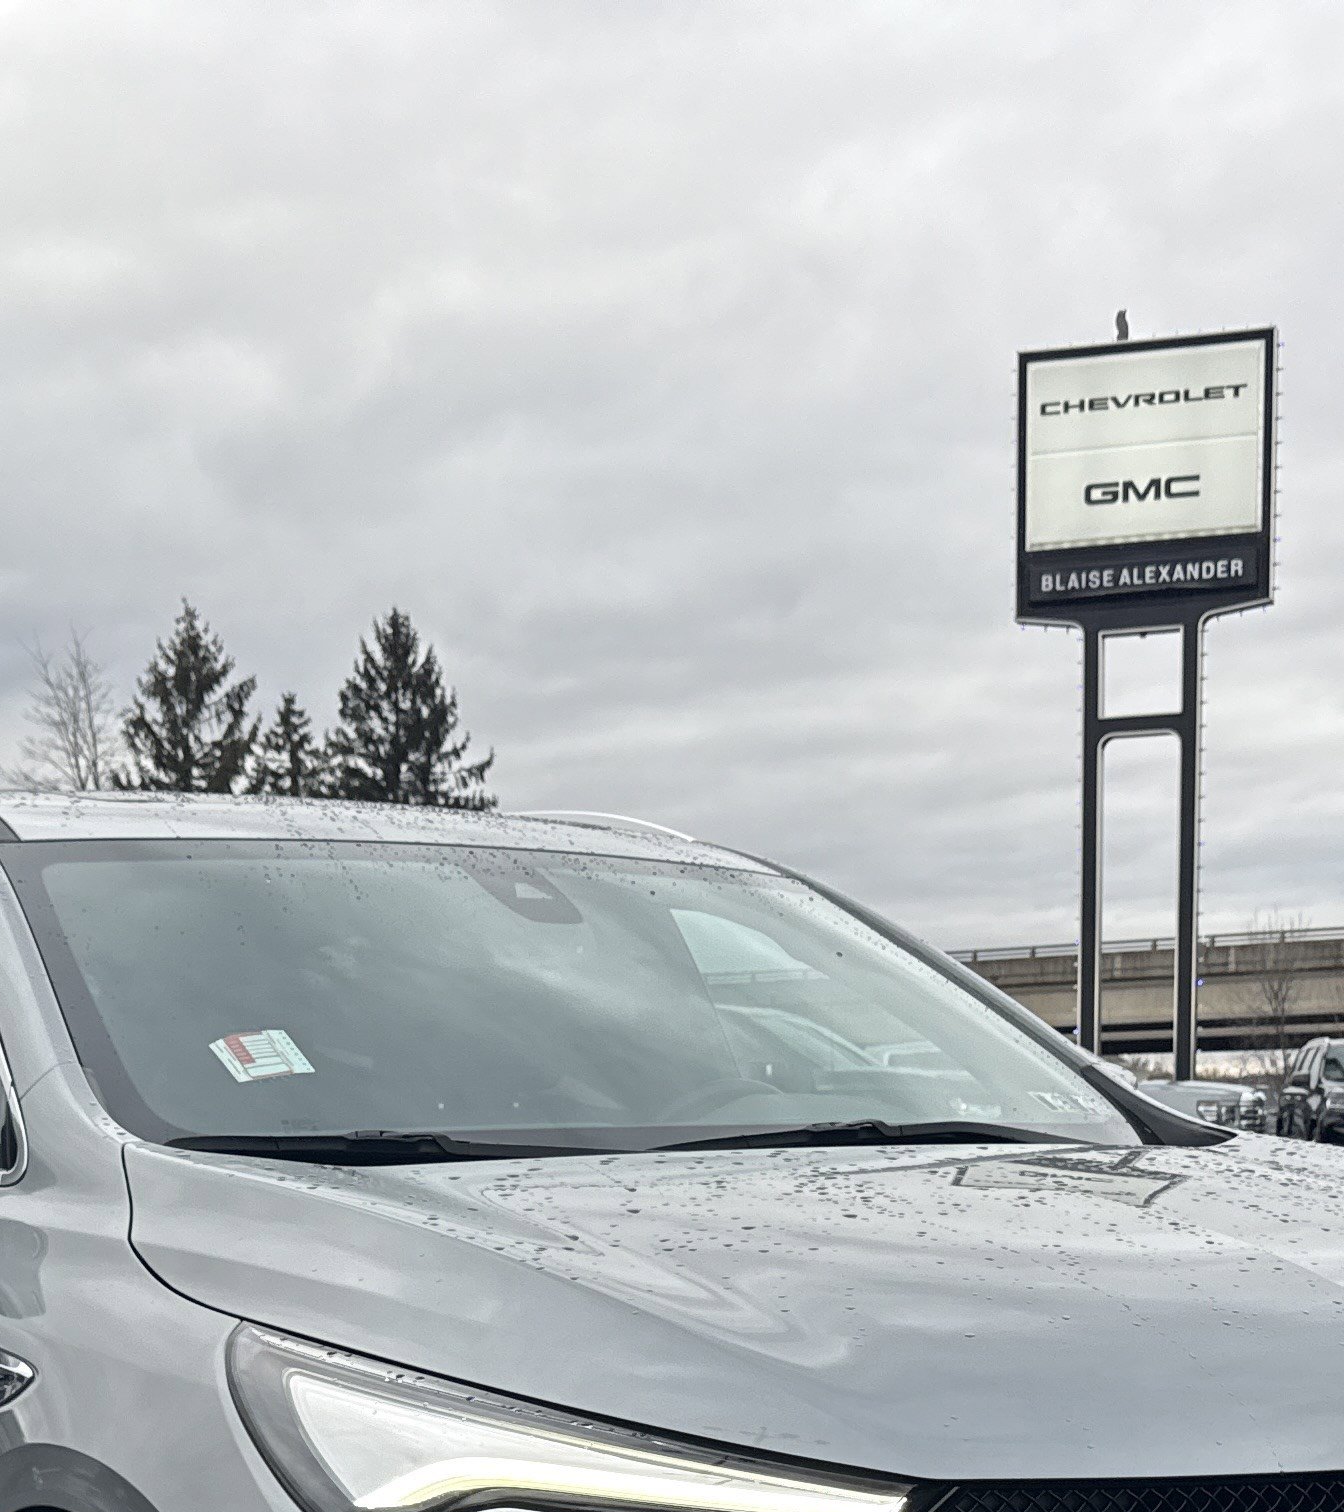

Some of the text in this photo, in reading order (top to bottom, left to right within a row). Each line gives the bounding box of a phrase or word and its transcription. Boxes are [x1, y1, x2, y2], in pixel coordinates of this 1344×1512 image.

[1040, 383, 1248, 416] CHEVROLET
[1084, 475, 1201, 506] GMC
[1040, 558, 1245, 593] BLAISE ALEXANDER
